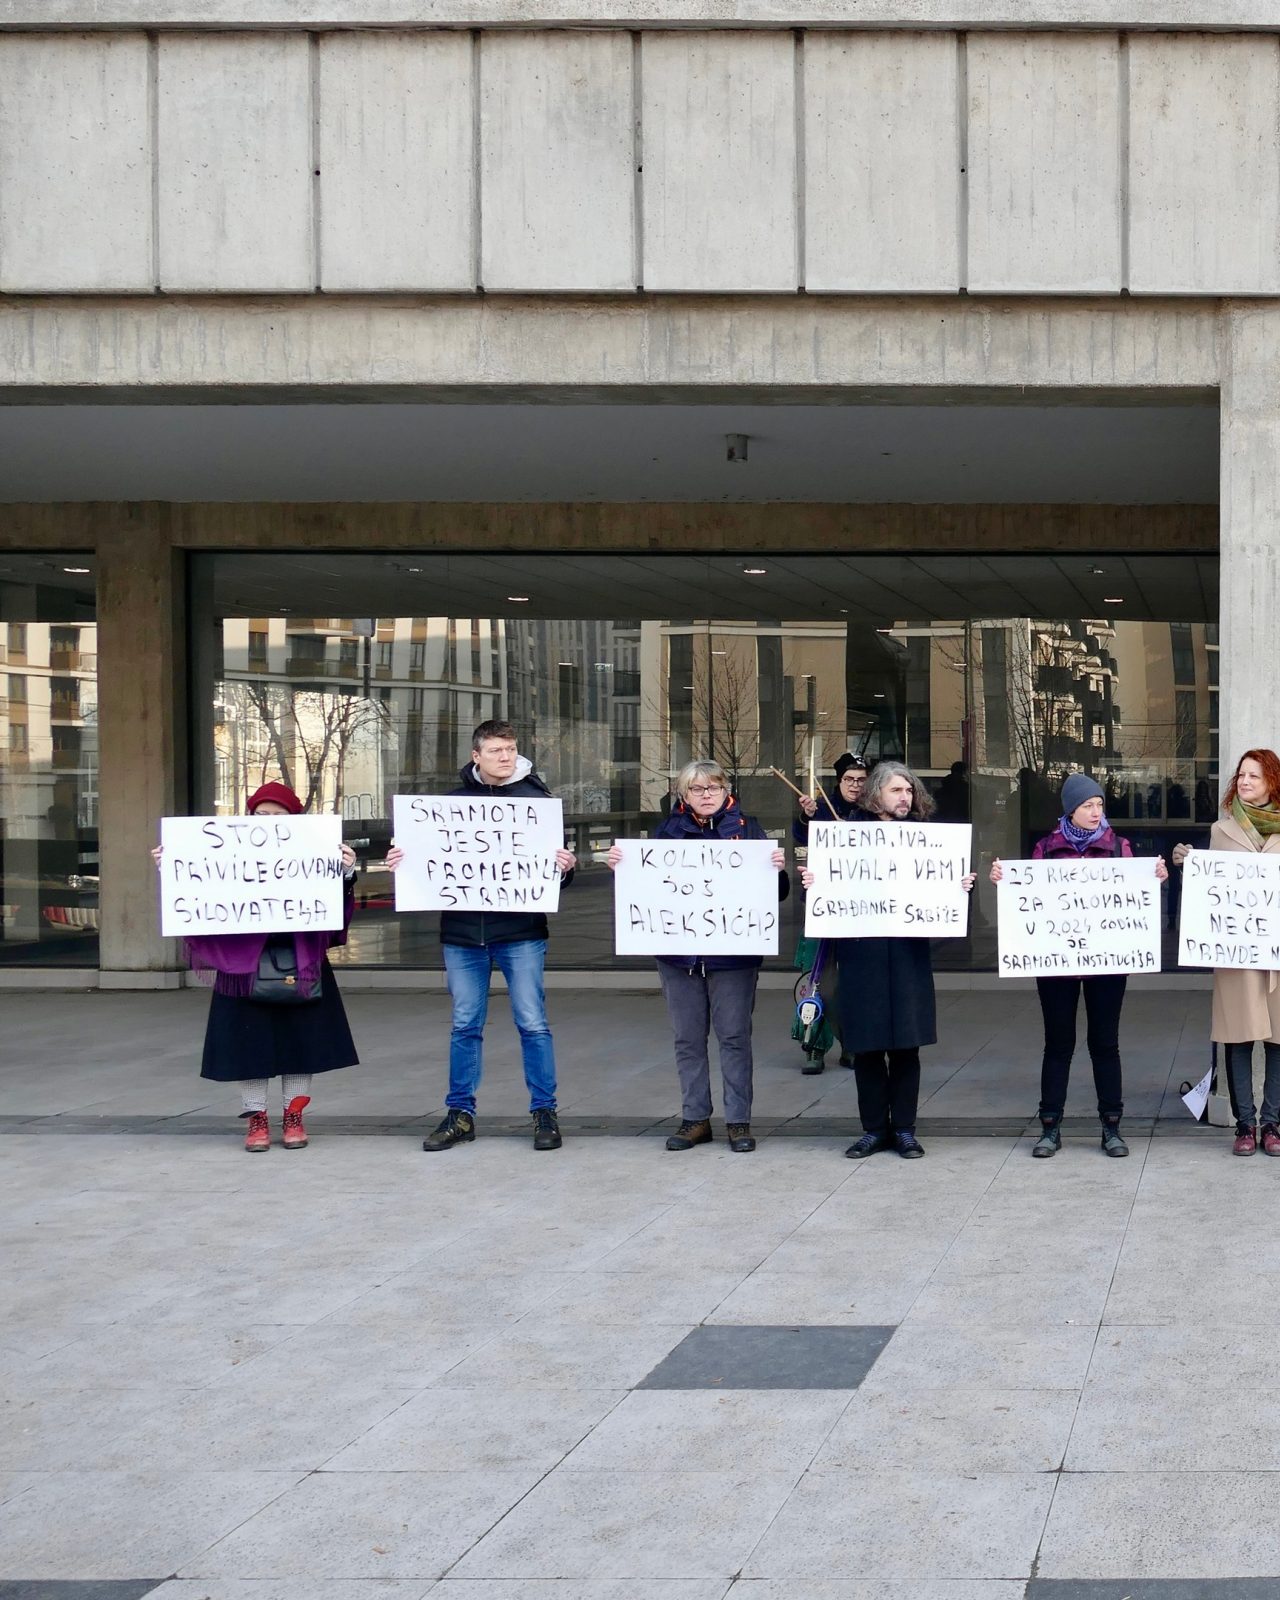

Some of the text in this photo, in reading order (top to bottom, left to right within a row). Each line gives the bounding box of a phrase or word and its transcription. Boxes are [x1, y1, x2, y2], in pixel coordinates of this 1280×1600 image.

[411, 799, 538, 826] SRAMOTA
[203, 821, 291, 848] STOP
[438, 830, 528, 857] JESTE
[641, 845, 743, 868] KOLIKO
[1192, 856, 1226, 878] SVE
[829, 858, 897, 882] HVALA
[1010, 867, 1034, 885] 25
[439, 886, 544, 907] STRANU
[1019, 897, 1044, 911] ZA
[629, 904, 775, 940] ALEKSIĆA?
[1026, 923, 1035, 935] U
[1100, 917, 1148, 930] GODINI
[1211, 913, 1269, 937] NEĆE
[1067, 936, 1088, 949] JE
[1187, 938, 1259, 964] PRAVDE
[1003, 950, 1154, 970] SRAMOTA INSTITUCIJA
